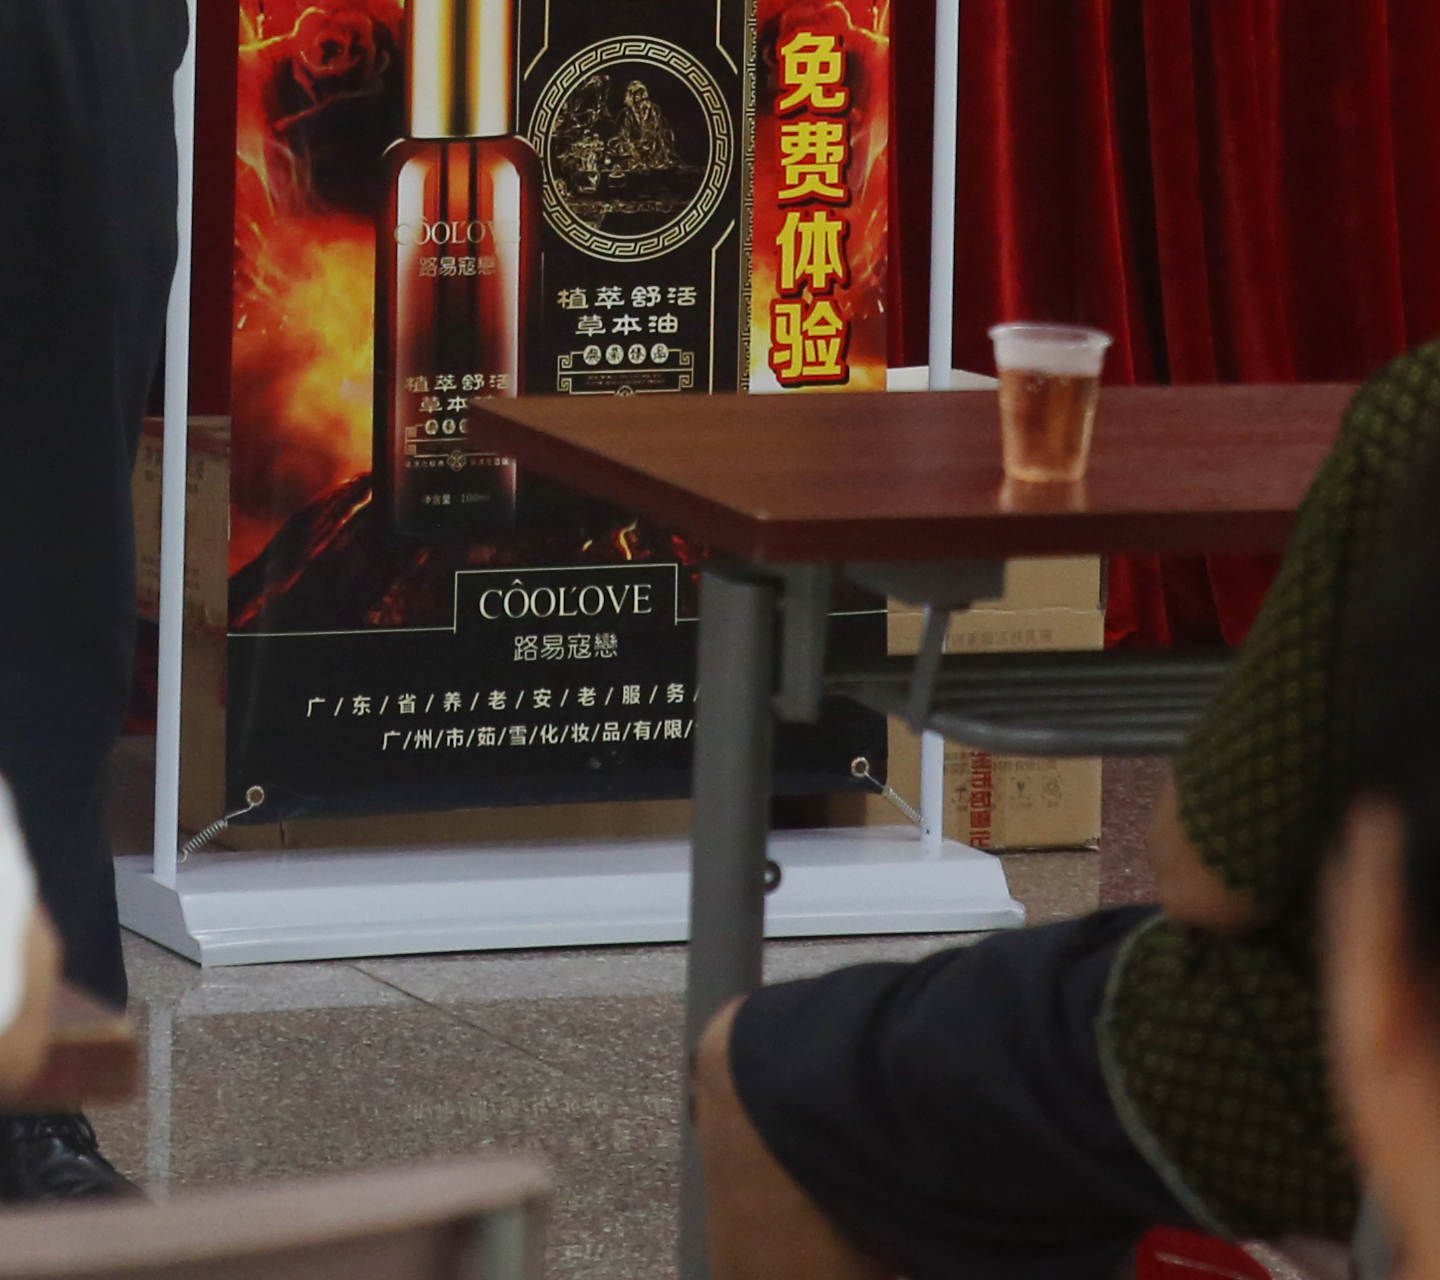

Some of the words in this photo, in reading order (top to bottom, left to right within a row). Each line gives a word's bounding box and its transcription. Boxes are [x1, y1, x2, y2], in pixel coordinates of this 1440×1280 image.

[773, 30, 847, 379] 免费体验
[574, 313, 679, 337] 草本油
